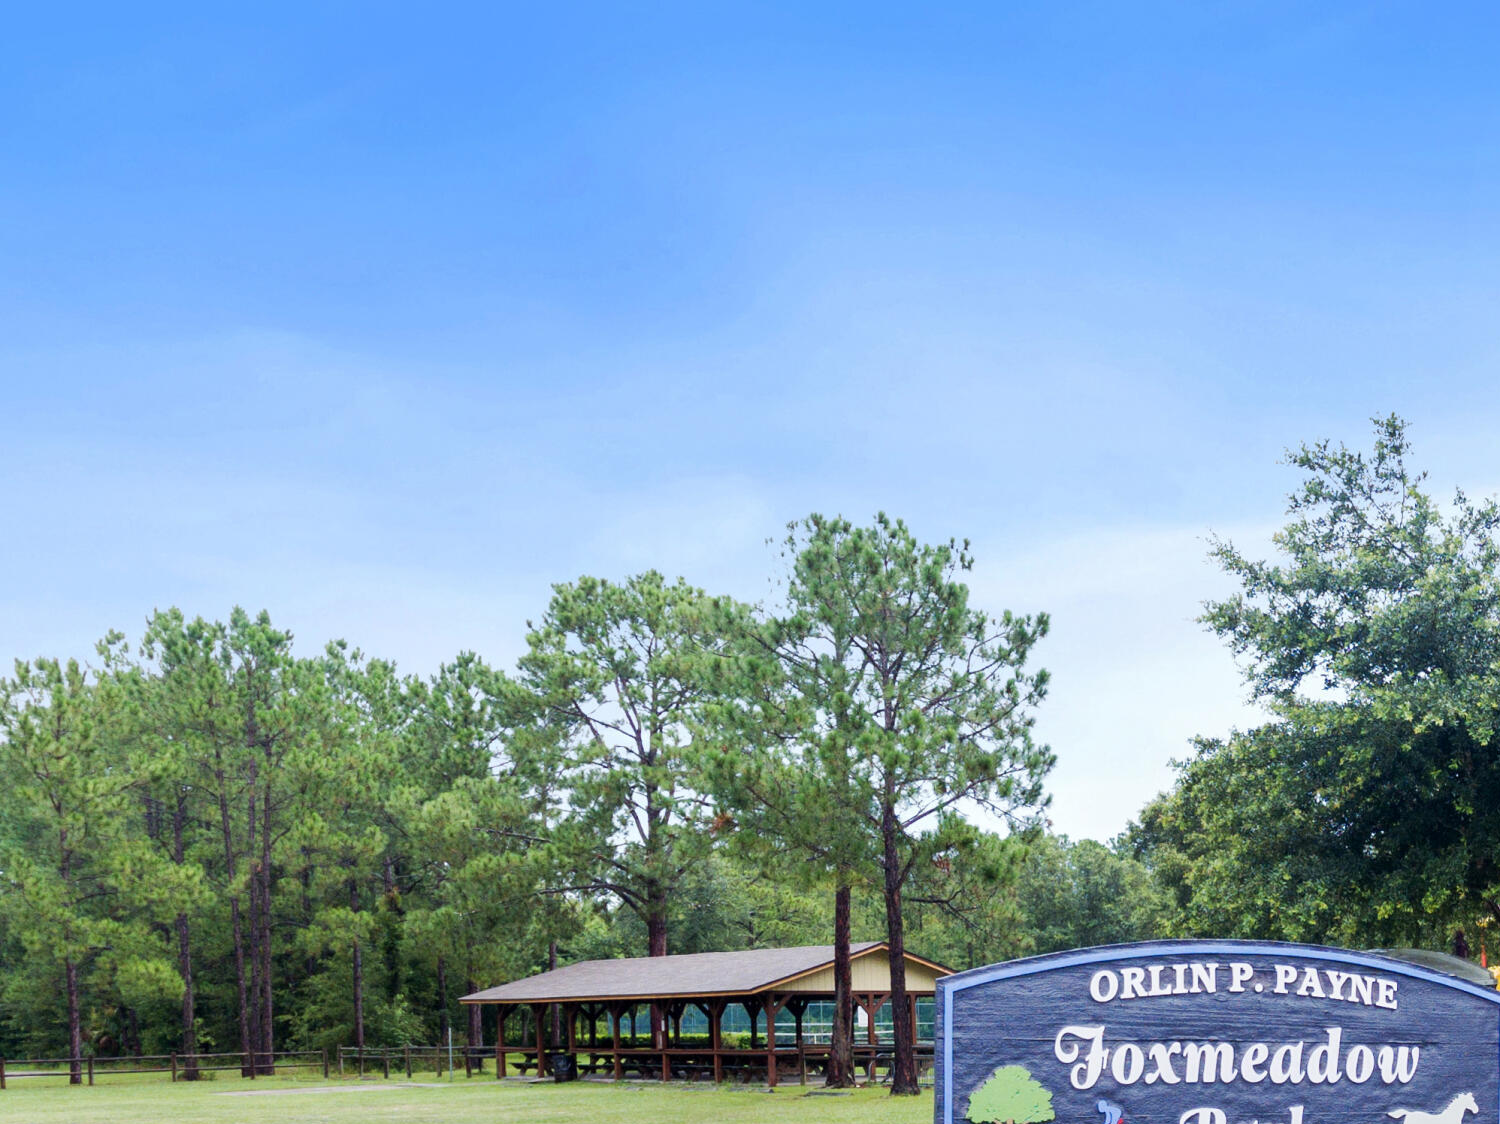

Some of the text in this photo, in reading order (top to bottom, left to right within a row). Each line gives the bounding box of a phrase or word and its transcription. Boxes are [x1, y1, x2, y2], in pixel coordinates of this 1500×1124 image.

[1090, 962, 1399, 1010] ORLIN P. PAYNE
[1054, 1025, 1420, 1090] Foxmeadow
